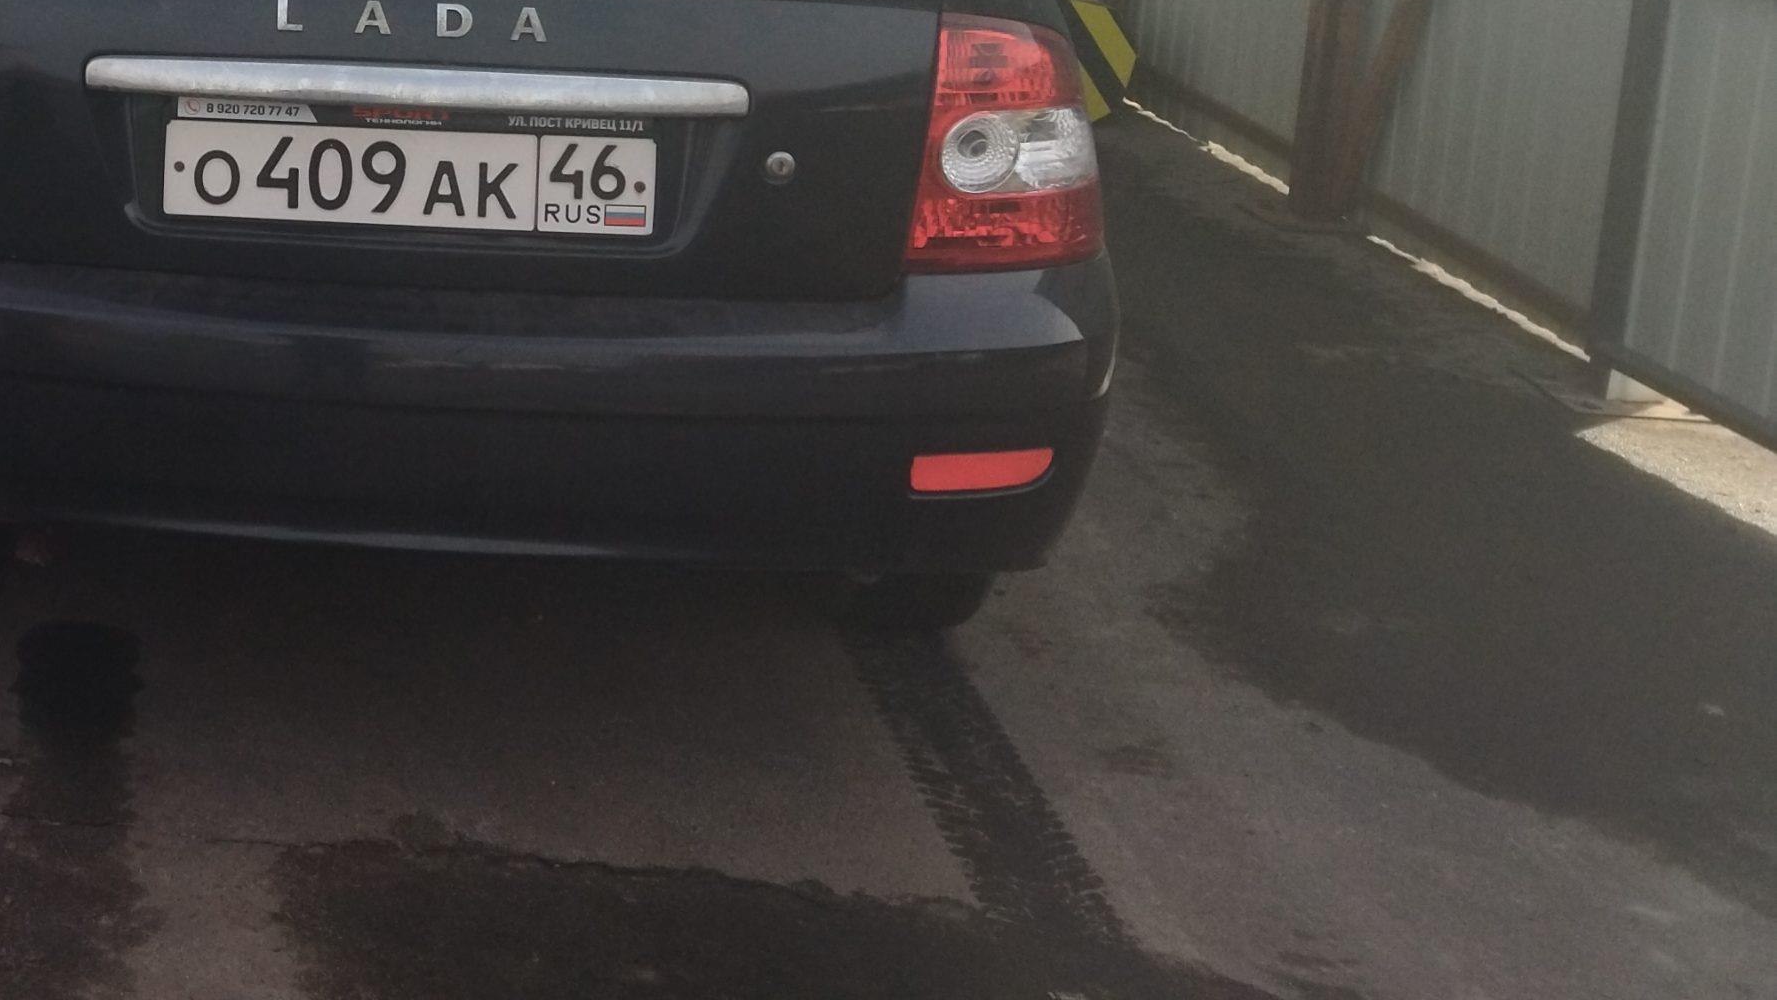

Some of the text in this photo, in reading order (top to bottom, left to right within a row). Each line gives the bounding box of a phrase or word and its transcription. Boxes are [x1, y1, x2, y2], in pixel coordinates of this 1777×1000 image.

[206, 102, 300, 117] 8 920 720 77 47
[508, 115, 644, 132] УЛ. ПОСТ КРИВЕЦ 11/1
[550, 144, 626, 201] 46
[544, 203, 601, 224] RUS
